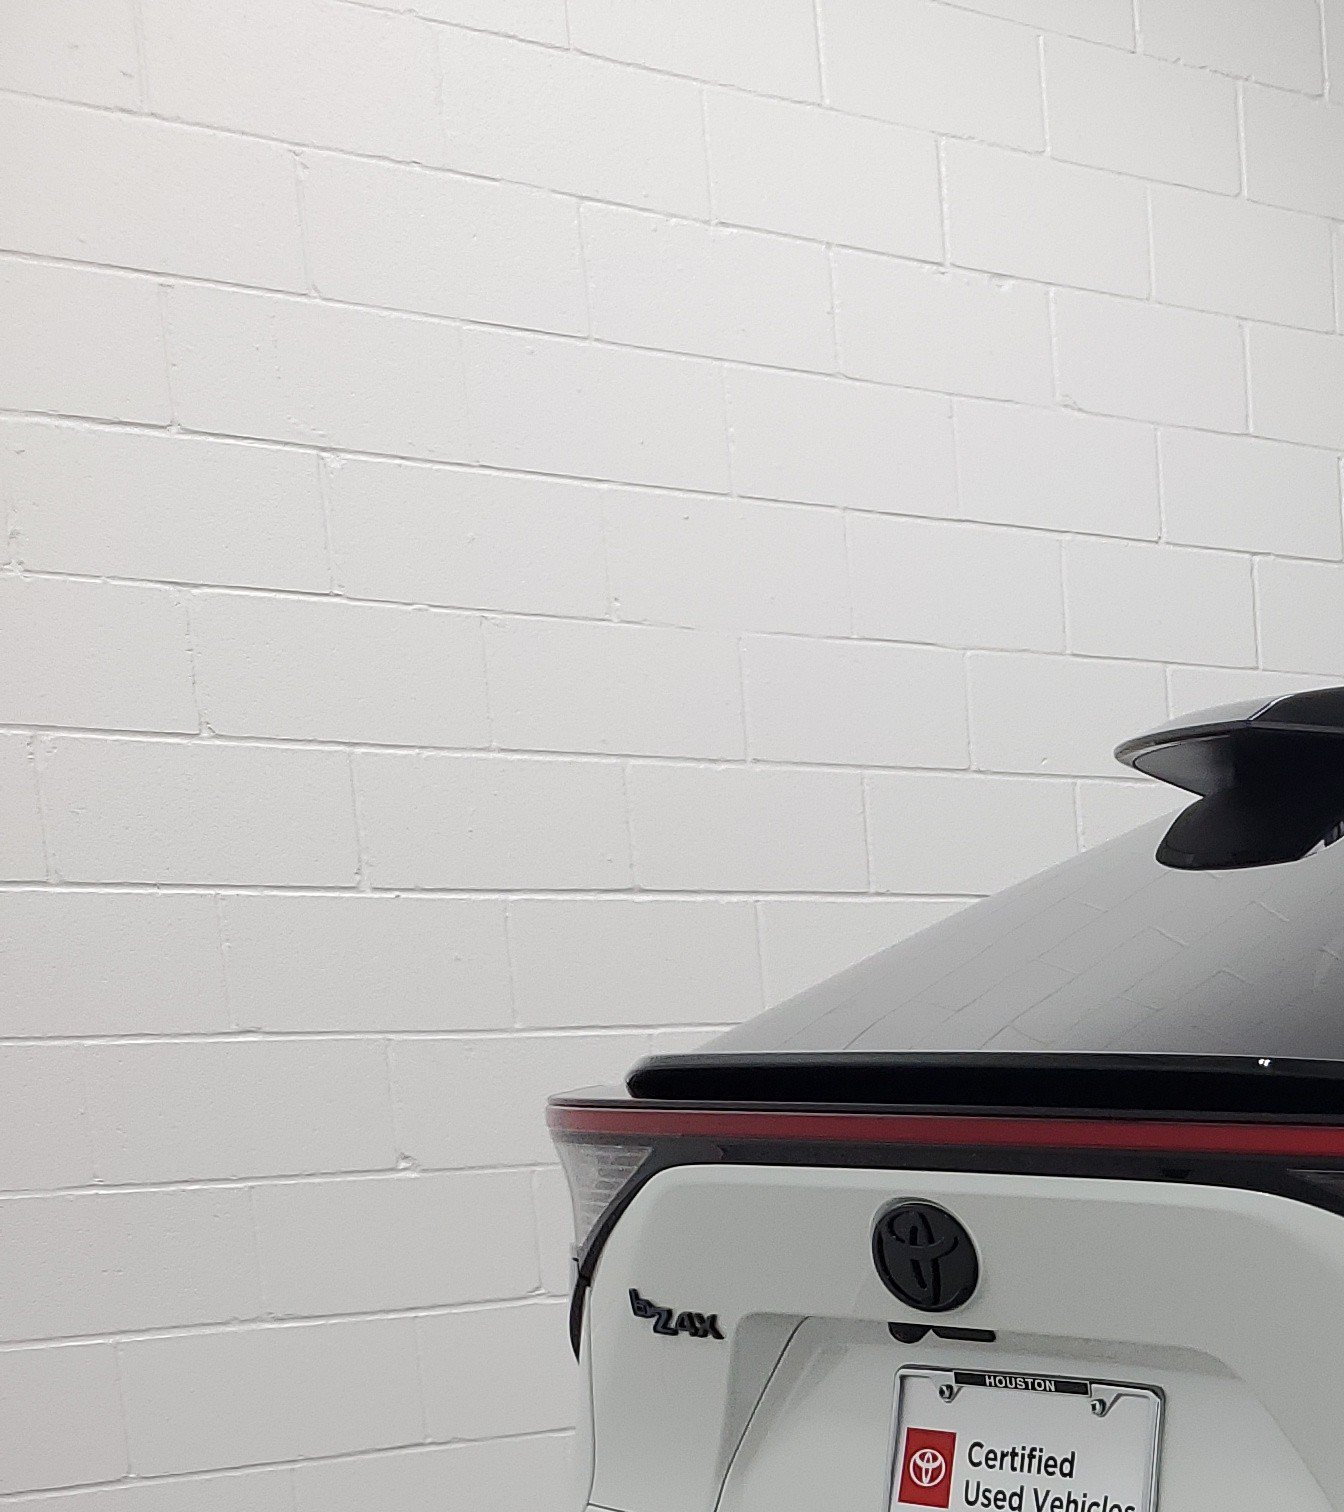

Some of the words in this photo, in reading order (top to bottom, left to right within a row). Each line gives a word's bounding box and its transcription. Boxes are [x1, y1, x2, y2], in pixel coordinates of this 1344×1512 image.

[985, 1375, 1056, 1392] HOUSTON
[967, 1441, 1077, 1479] Certified
[963, 1479, 1025, 1512] Used
